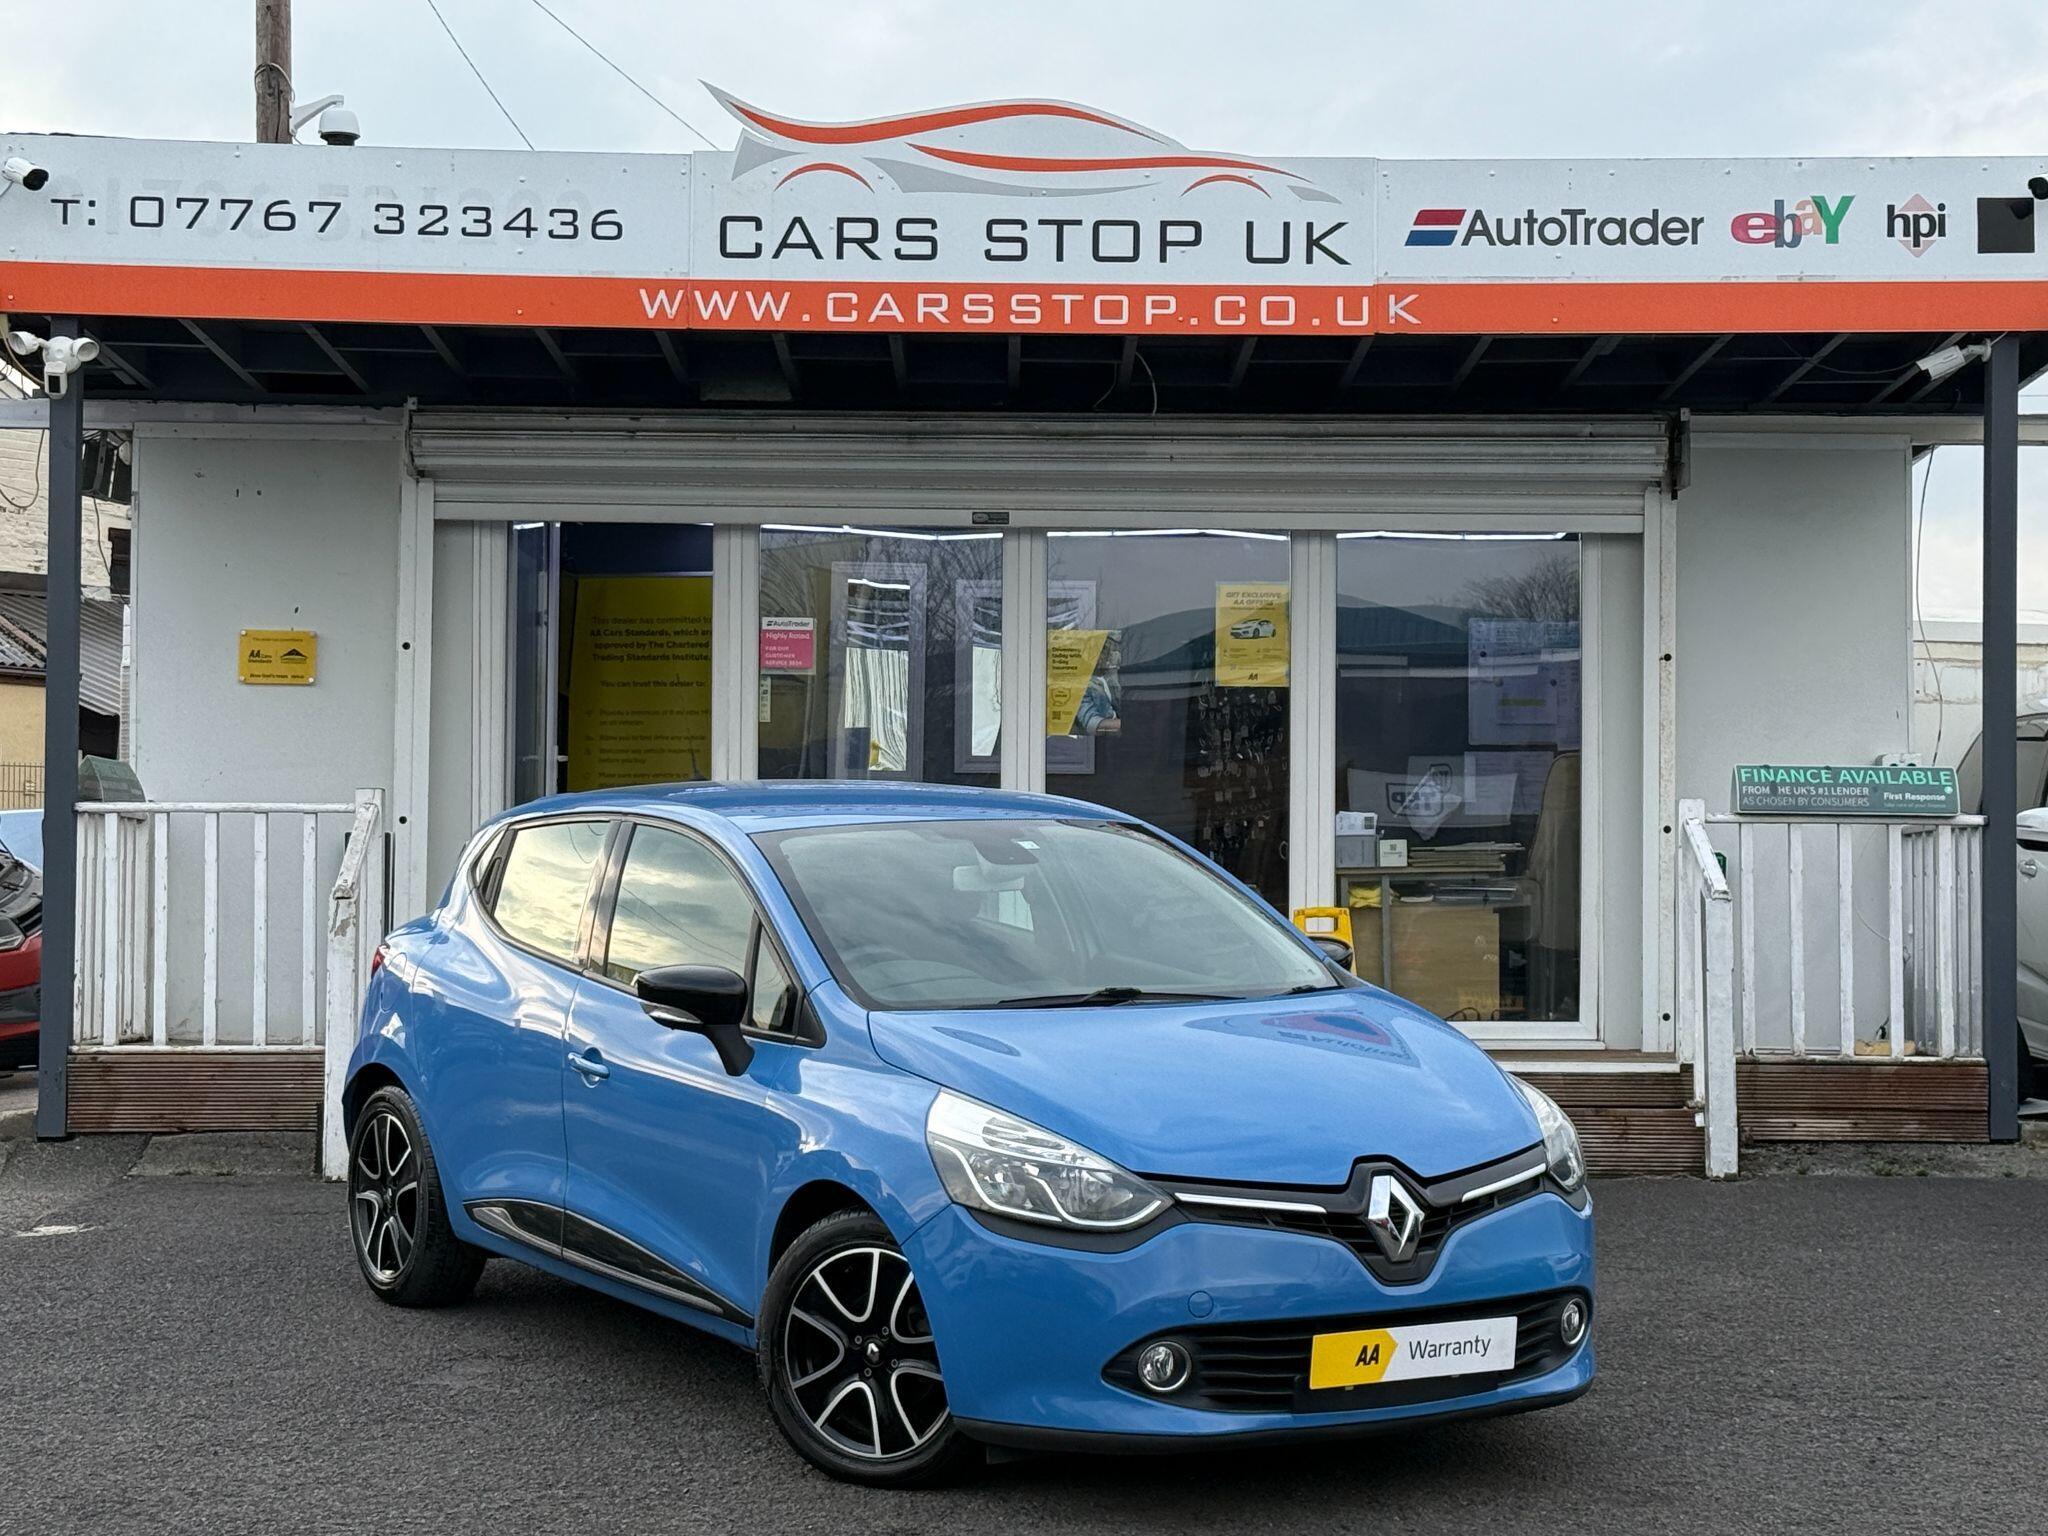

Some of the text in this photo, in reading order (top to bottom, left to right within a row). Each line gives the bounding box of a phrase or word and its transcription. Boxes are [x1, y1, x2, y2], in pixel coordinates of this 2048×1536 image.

[50, 196, 623, 242] T: 07767 323436
[1886, 203, 1947, 248] hpi
[1461, 208, 1705, 247] AutoTrader
[719, 215, 1352, 265] CARS STOP UK
[638, 287, 1423, 328] WWW.CARSSTOP.CO.UK
[603, 628, 623, 637] Cars
[673, 628, 700, 637] which
[594, 640, 710, 651] approved by The Chartered
[592, 653, 625, 663] Trading
[626, 653, 670, 662] Standards
[653, 680, 668, 688] this
[1740, 768, 1953, 786] FINANCE AVAILABLE
[1742, 785, 1770, 795] FROM
[1772, 786, 1792, 795] HE
[1794, 786, 1816, 796] UK'S
[1831, 786, 1870, 796] LENDER
[1884, 792, 1947, 803] First Response
[1742, 796, 1870, 808] AS CHOSEN BY CONSUMERS
[1354, 1334, 1492, 1367] AA Warranty
